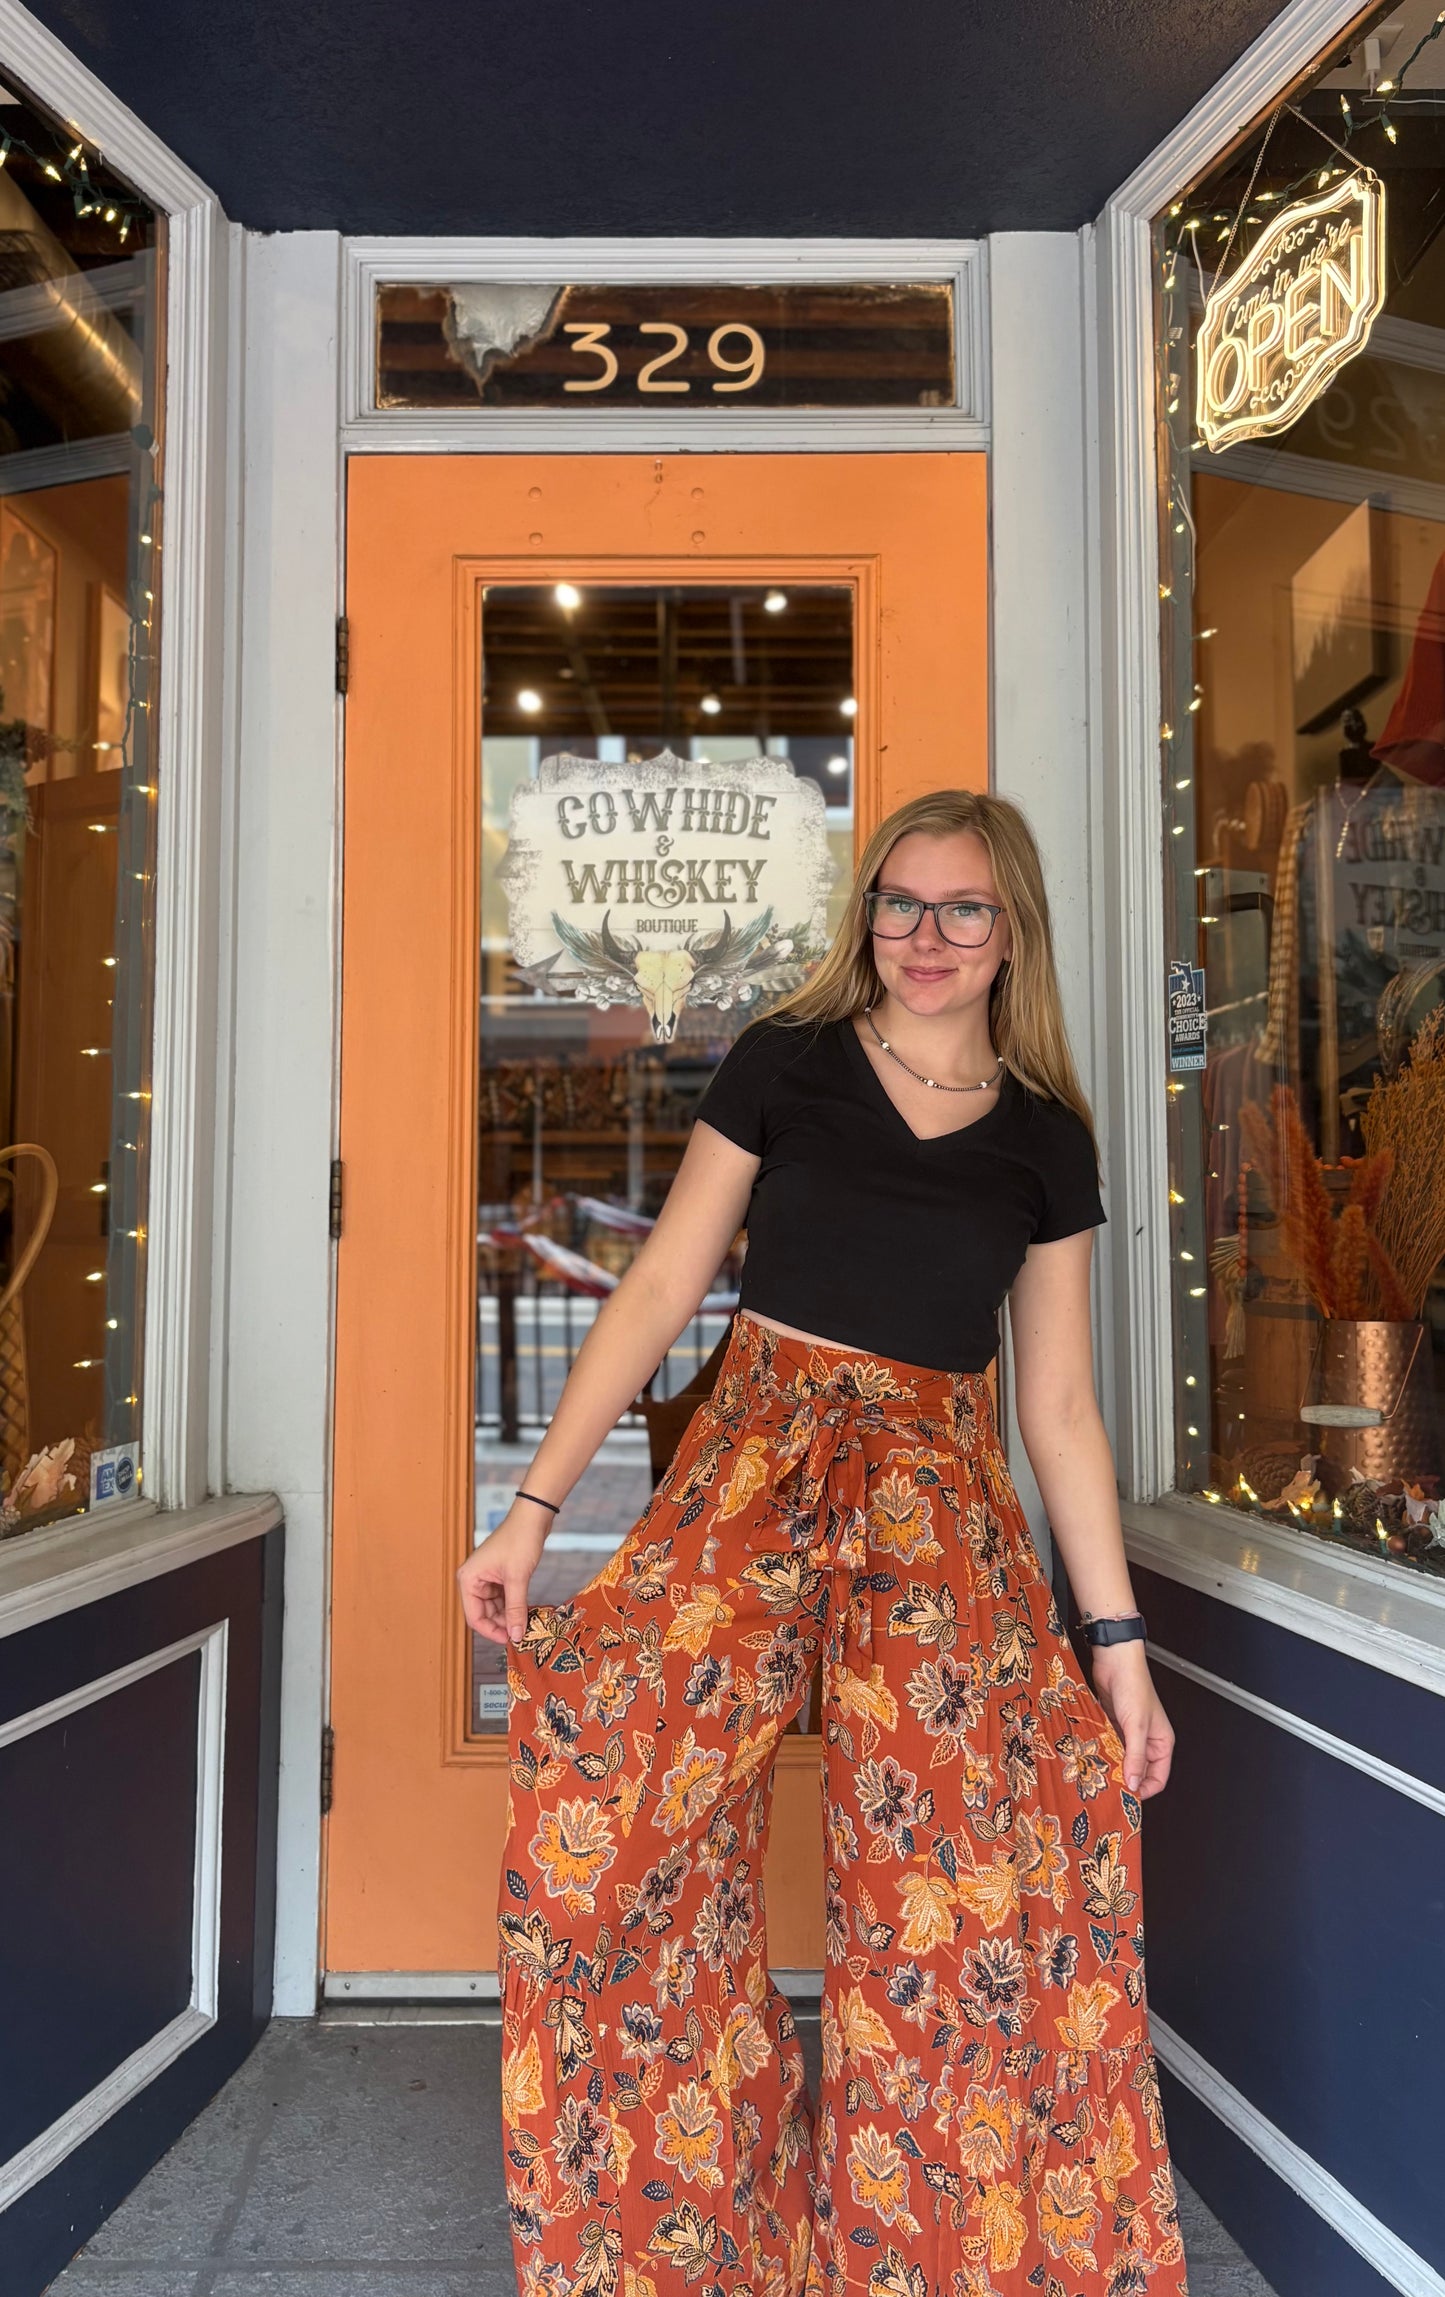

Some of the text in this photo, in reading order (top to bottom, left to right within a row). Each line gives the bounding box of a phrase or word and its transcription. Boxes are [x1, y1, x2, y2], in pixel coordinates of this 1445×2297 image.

[1222, 217, 1352, 340] Come in we're
[1206, 234, 1365, 414] OPEN
[562, 322, 766, 393] 329
[556, 788, 777, 840] COWHIDE
[655, 834, 675, 857] &
[561, 859, 768, 909] WHISKEY
[636, 919, 699, 934] BOUTIQUE
[1176, 993, 1197, 1008] 2023
[1169, 1013, 1207, 1034] CHOICE
[1175, 1031, 1201, 1043] AWARDS
[1172, 1055, 1205, 1069] WINNER
